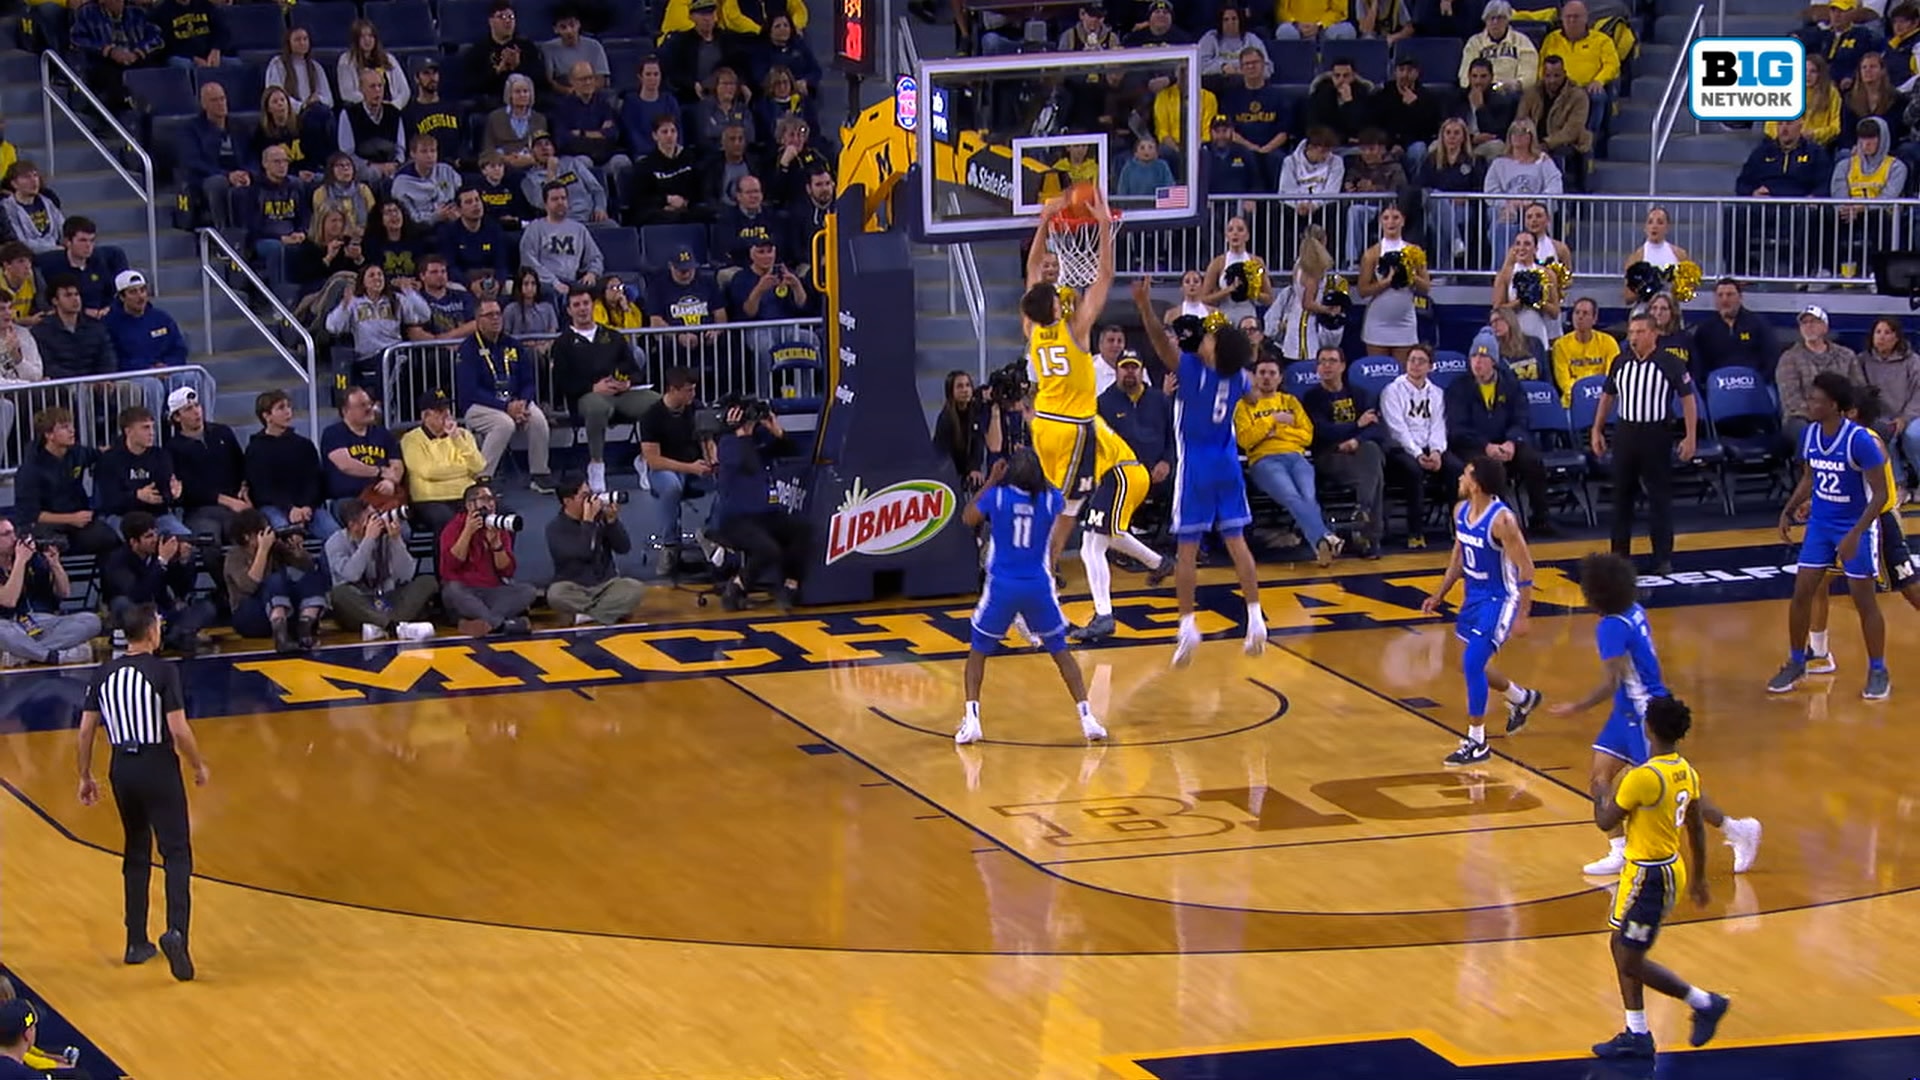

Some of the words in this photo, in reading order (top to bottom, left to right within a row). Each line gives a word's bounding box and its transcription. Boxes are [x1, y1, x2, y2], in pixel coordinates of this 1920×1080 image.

[417, 113, 457, 134] MICHIGAN
[875, 143, 893, 183] M
[550, 235, 575, 255] M
[383, 251, 415, 275] M
[1038, 346, 1069, 376] 15
[1370, 364, 1400, 374] UMCU
[1438, 360, 1467, 370] UMCU
[1725, 376, 1755, 386] UMCU
[1408, 398, 1431, 419] M
[1817, 472, 1842, 494] 22
[829, 490, 944, 560] LIBMAN
[1088, 509, 1105, 527] M
[1013, 516, 1032, 548] 11
[1464, 545, 1476, 568] 0
[1894, 560, 1914, 580] M
[1625, 920, 1651, 942] M
